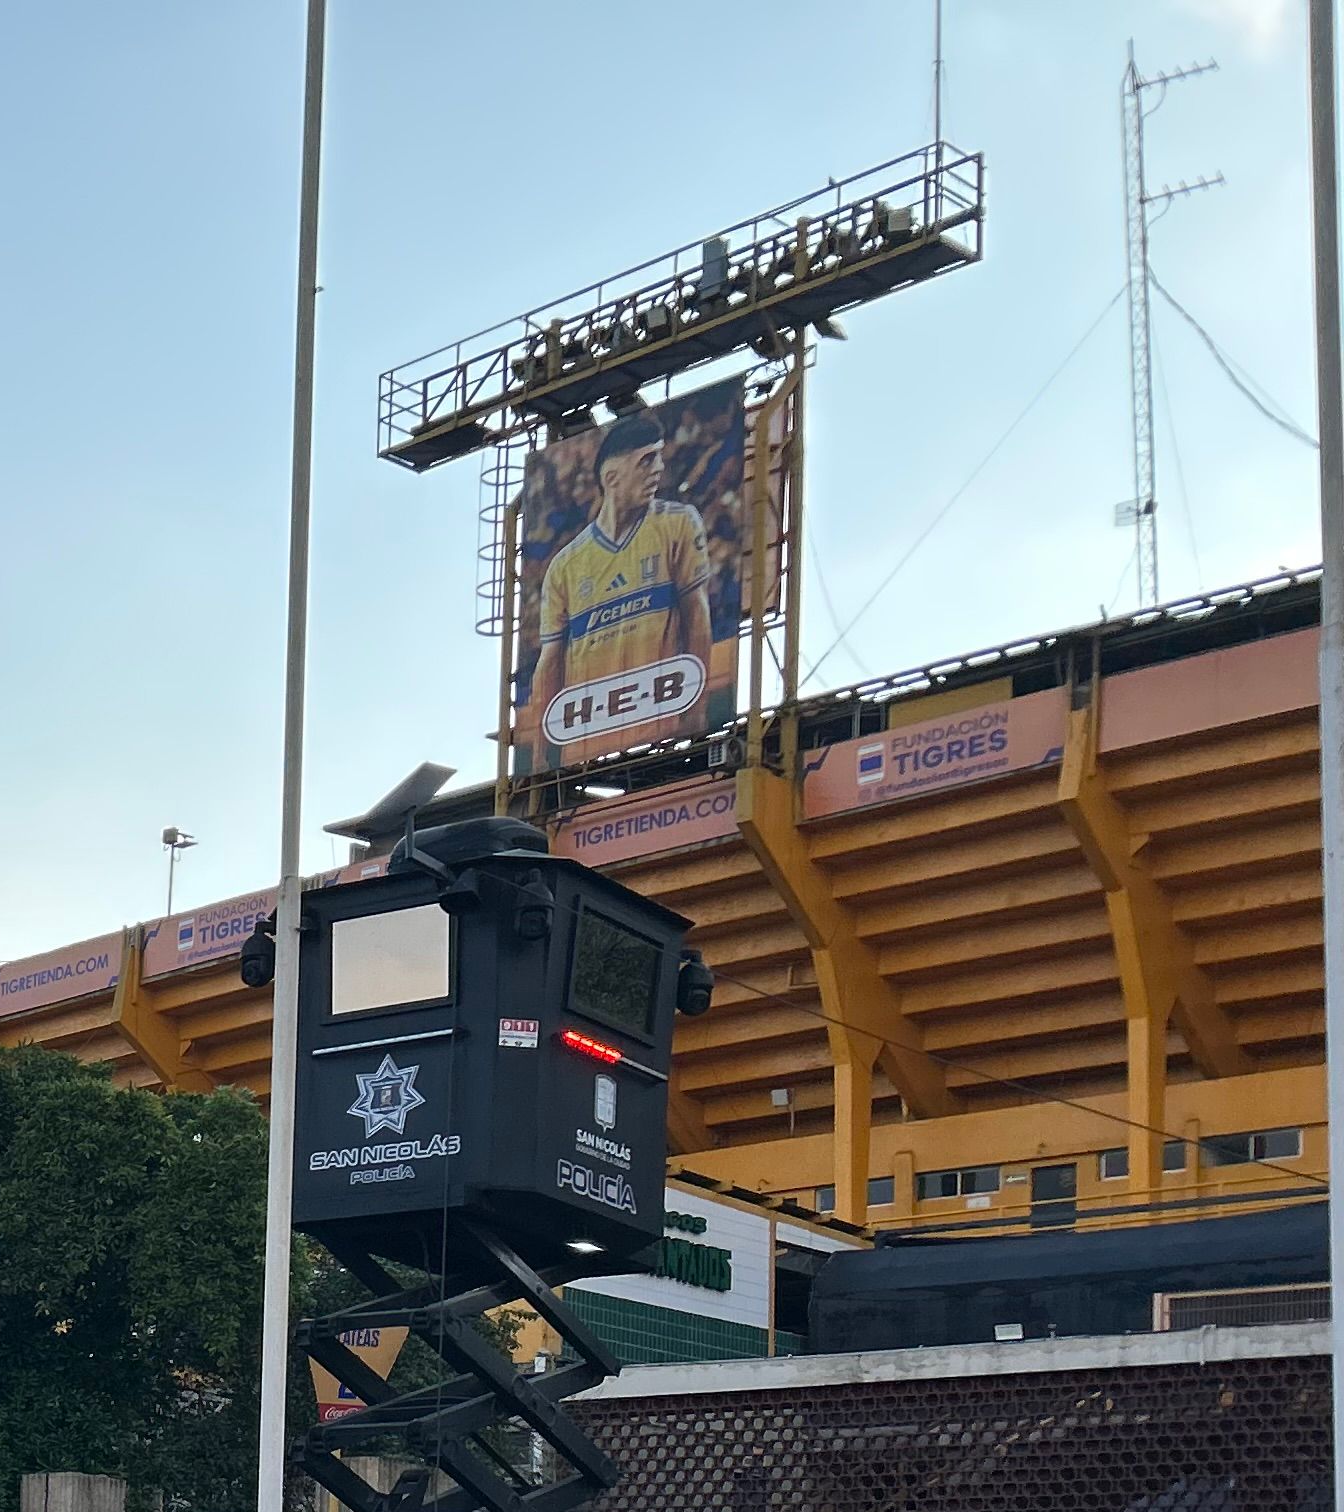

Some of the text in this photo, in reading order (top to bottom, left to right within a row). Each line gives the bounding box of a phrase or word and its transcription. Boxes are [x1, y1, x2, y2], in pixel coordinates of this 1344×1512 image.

[600, 594, 652, 624] CEMEX
[564, 671, 685, 730] H-E-B
[892, 710, 1009, 752] FUNDACIÓN
[893, 729, 1008, 775] TIGRES
[199, 896, 268, 924] FUNDACIÓN
[1, 953, 109, 997] TIGRETIENDA.COM
[502, 1020, 537, 1032] 911
[310, 1134, 461, 1171] SAN NICOLÁS
[576, 1129, 631, 1161] SAN NICOLÁS
[350, 1163, 415, 1185] POLICÍA
[557, 1159, 637, 1214] POLICÍA
[343, 1328, 380, 1347] ATEAS
